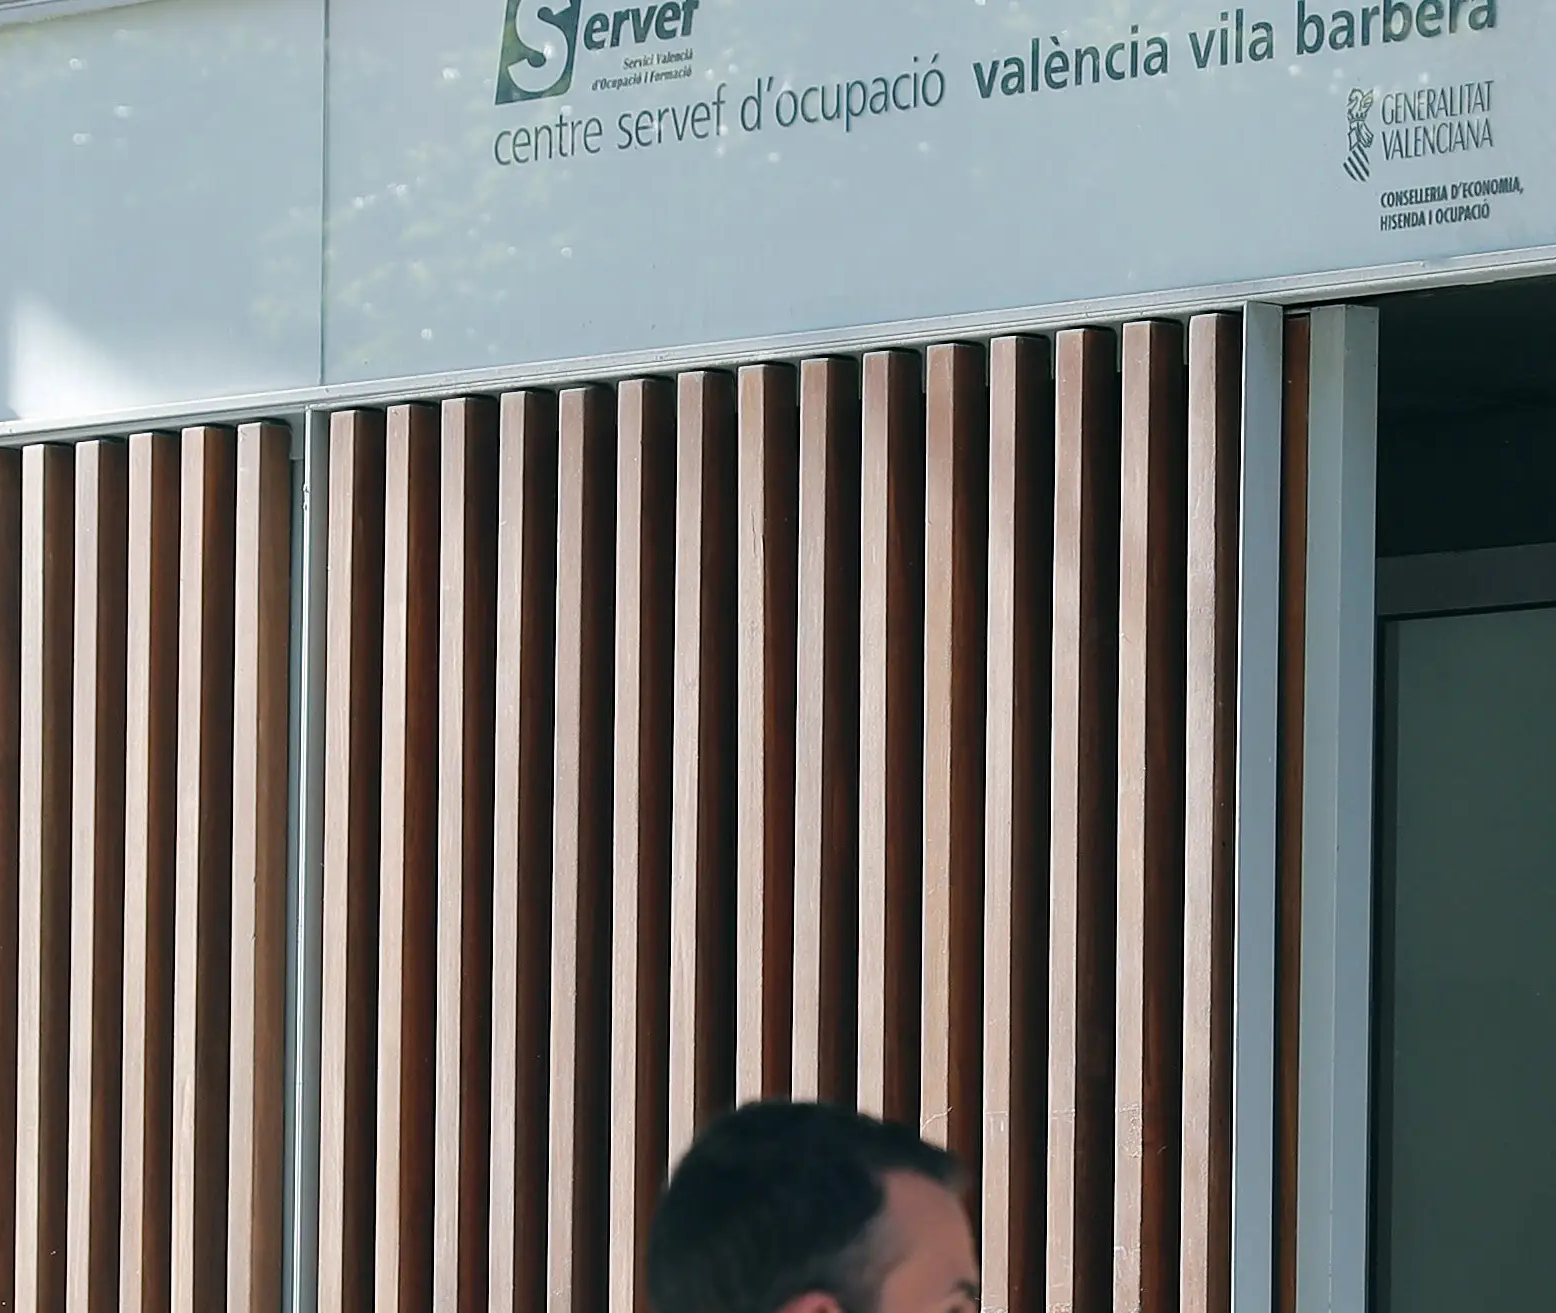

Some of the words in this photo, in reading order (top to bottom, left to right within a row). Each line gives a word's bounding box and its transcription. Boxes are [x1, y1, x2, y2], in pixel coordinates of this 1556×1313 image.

[623, 53, 654, 70] Servici
[494, 113, 604, 166] centre
[616, 83, 727, 150] servef
[740, 53, 945, 132] d'ocupació
[972, 24, 1169, 99] valència
[1189, 9, 1274, 69] vila
[1381, 80, 1494, 125] GENERALITAT
[1381, 118, 1494, 161] VALENCIANA
[1380, 185, 1448, 208] CONSELLERIA
[1451, 177, 1524, 201] D'ECONOMIA,
[1380, 210, 1426, 231] HISENDA
[1429, 209, 1432, 225] I
[1435, 199, 1491, 225] OCUPACIÓ
